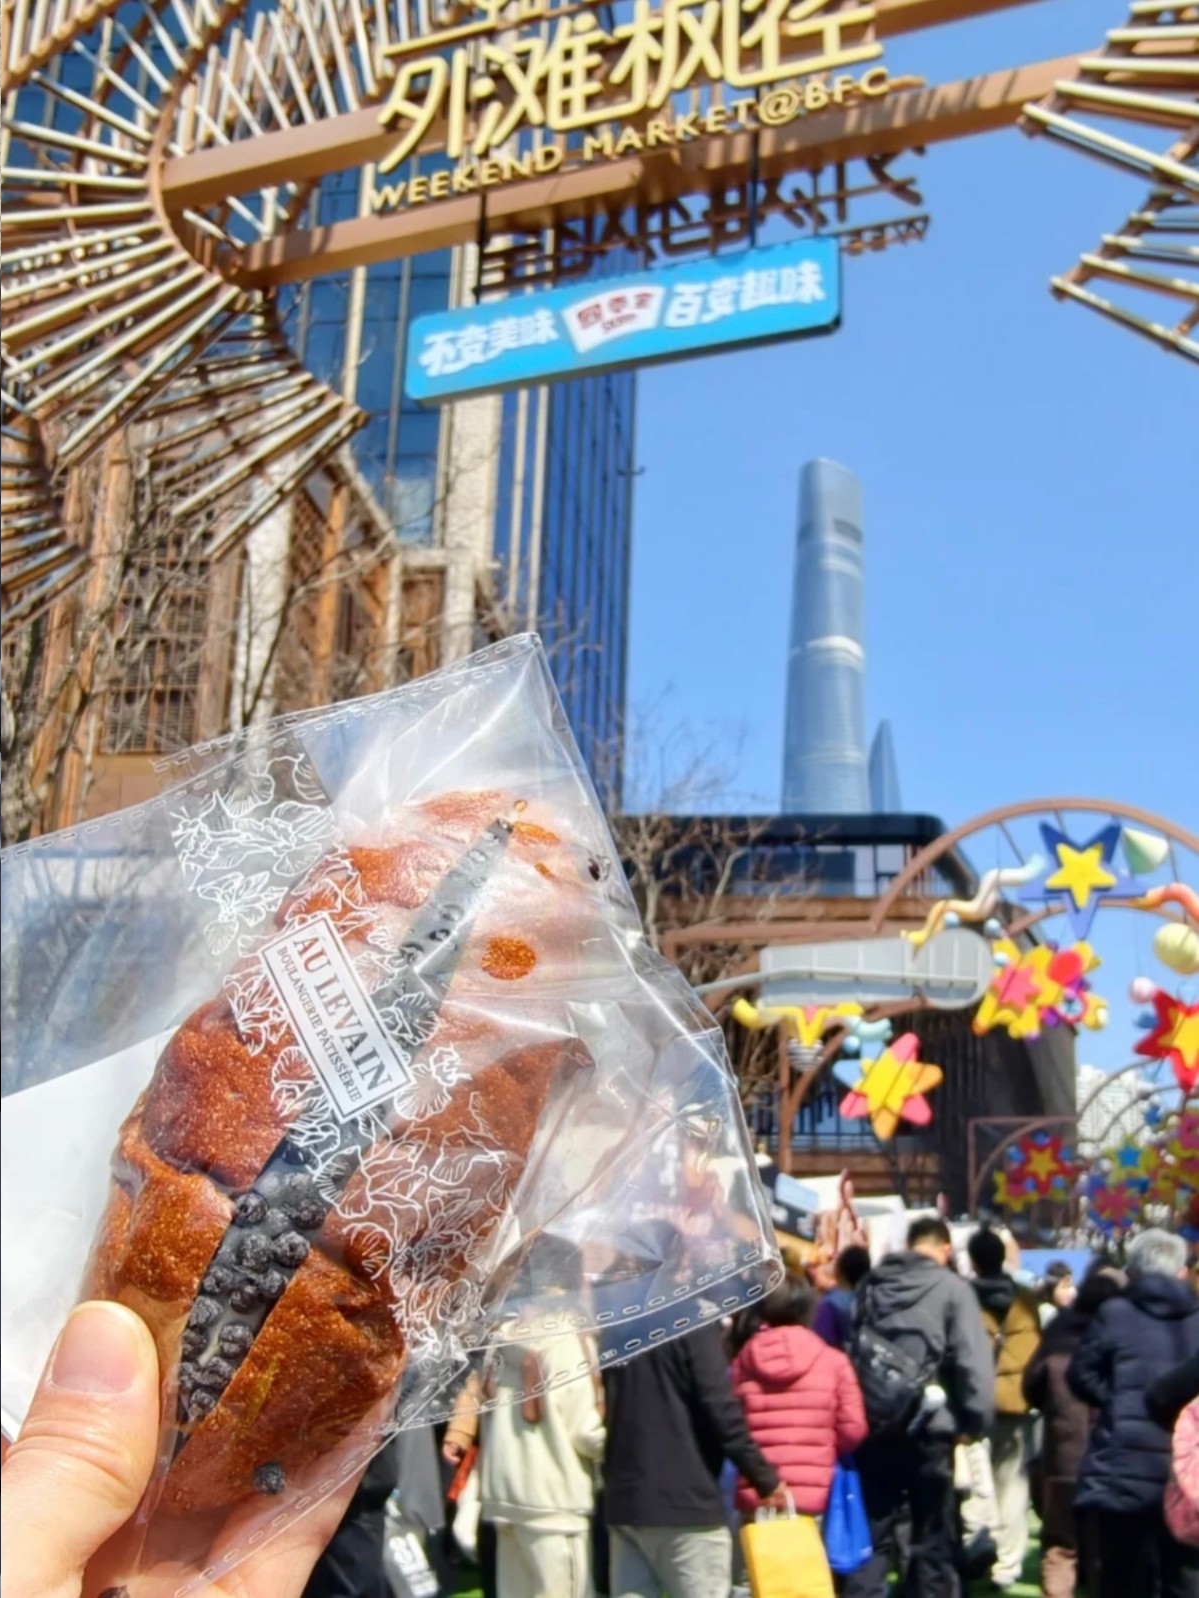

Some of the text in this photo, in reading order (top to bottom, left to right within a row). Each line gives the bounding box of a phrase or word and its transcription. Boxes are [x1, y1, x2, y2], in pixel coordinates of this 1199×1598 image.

[369, 66, 890, 210] WEEKEND MARKET@BFC
[277, 945, 323, 1029] BOULANGERIE
[292, 937, 392, 1091] AU LEVAIN
